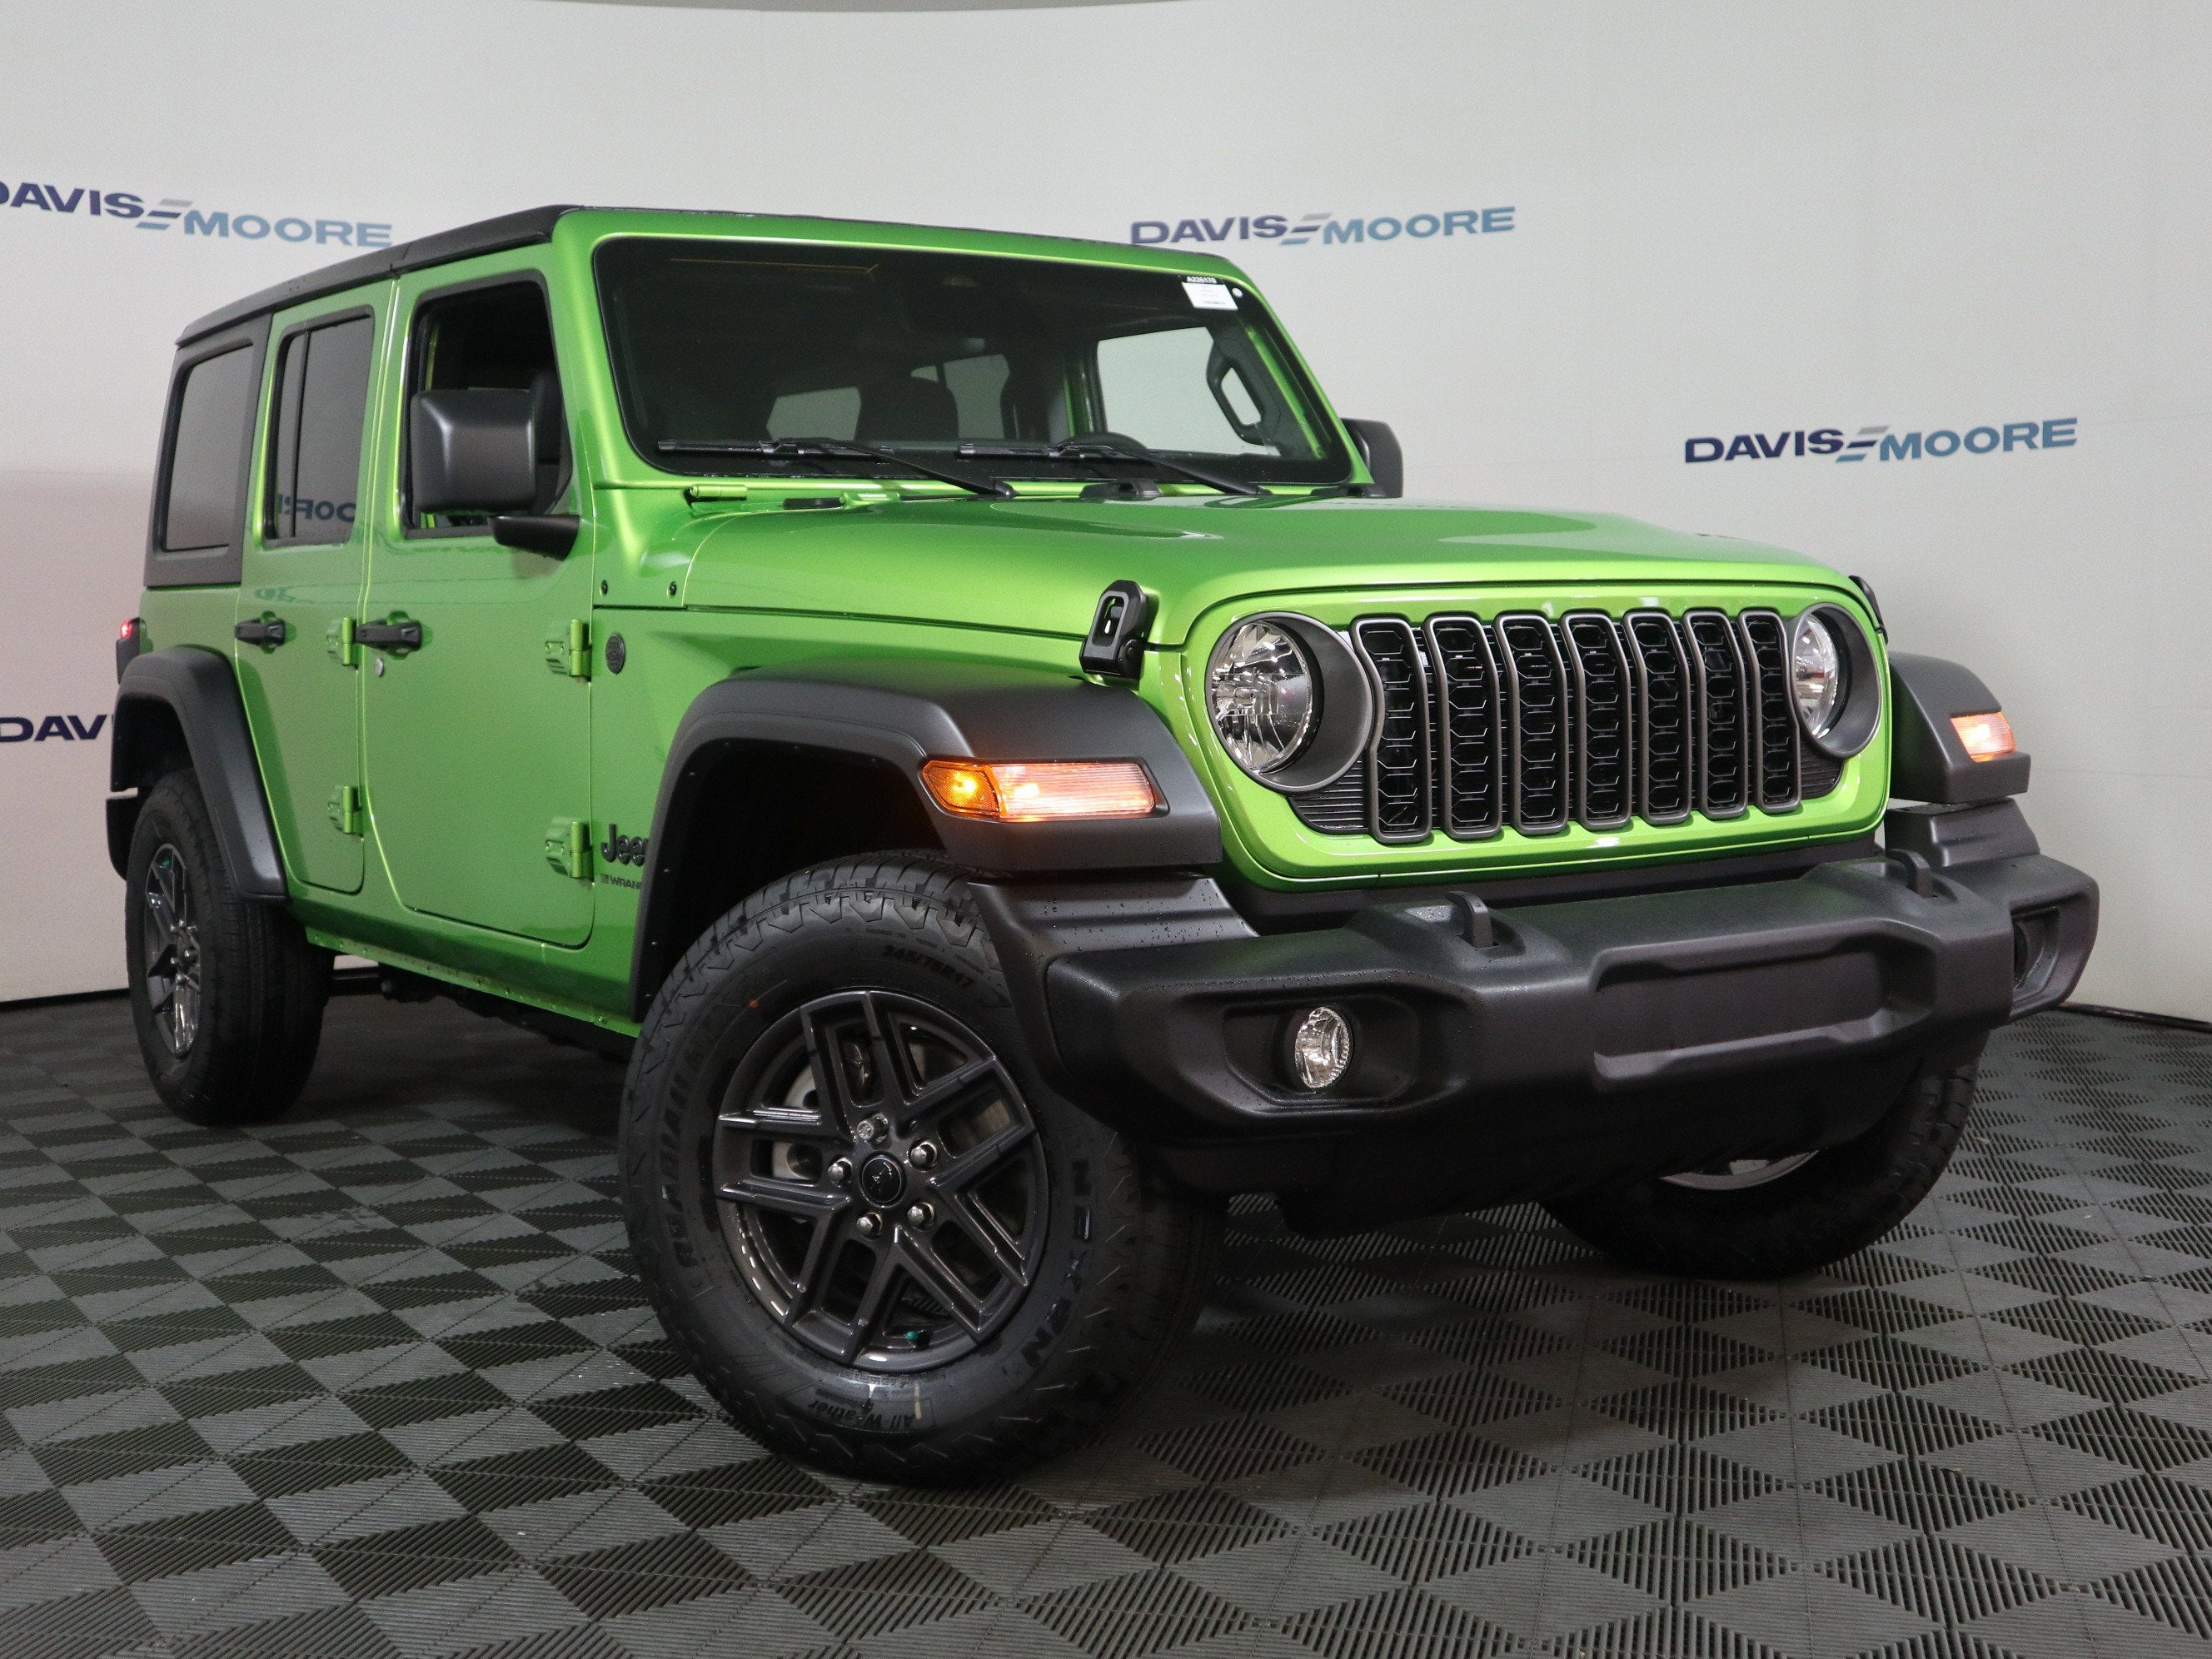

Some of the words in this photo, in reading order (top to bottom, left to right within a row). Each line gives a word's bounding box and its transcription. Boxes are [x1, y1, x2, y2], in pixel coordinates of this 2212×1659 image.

[0, 181, 145, 220] AVIS
[183, 210, 393, 247] MOORE
[1131, 214, 1288, 245] DAVIS
[1323, 206, 1516, 245] MOORE
[1684, 427, 1845, 465] DAVIS
[1879, 416, 2078, 462] MOORE
[0, 714, 114, 744] DAV
